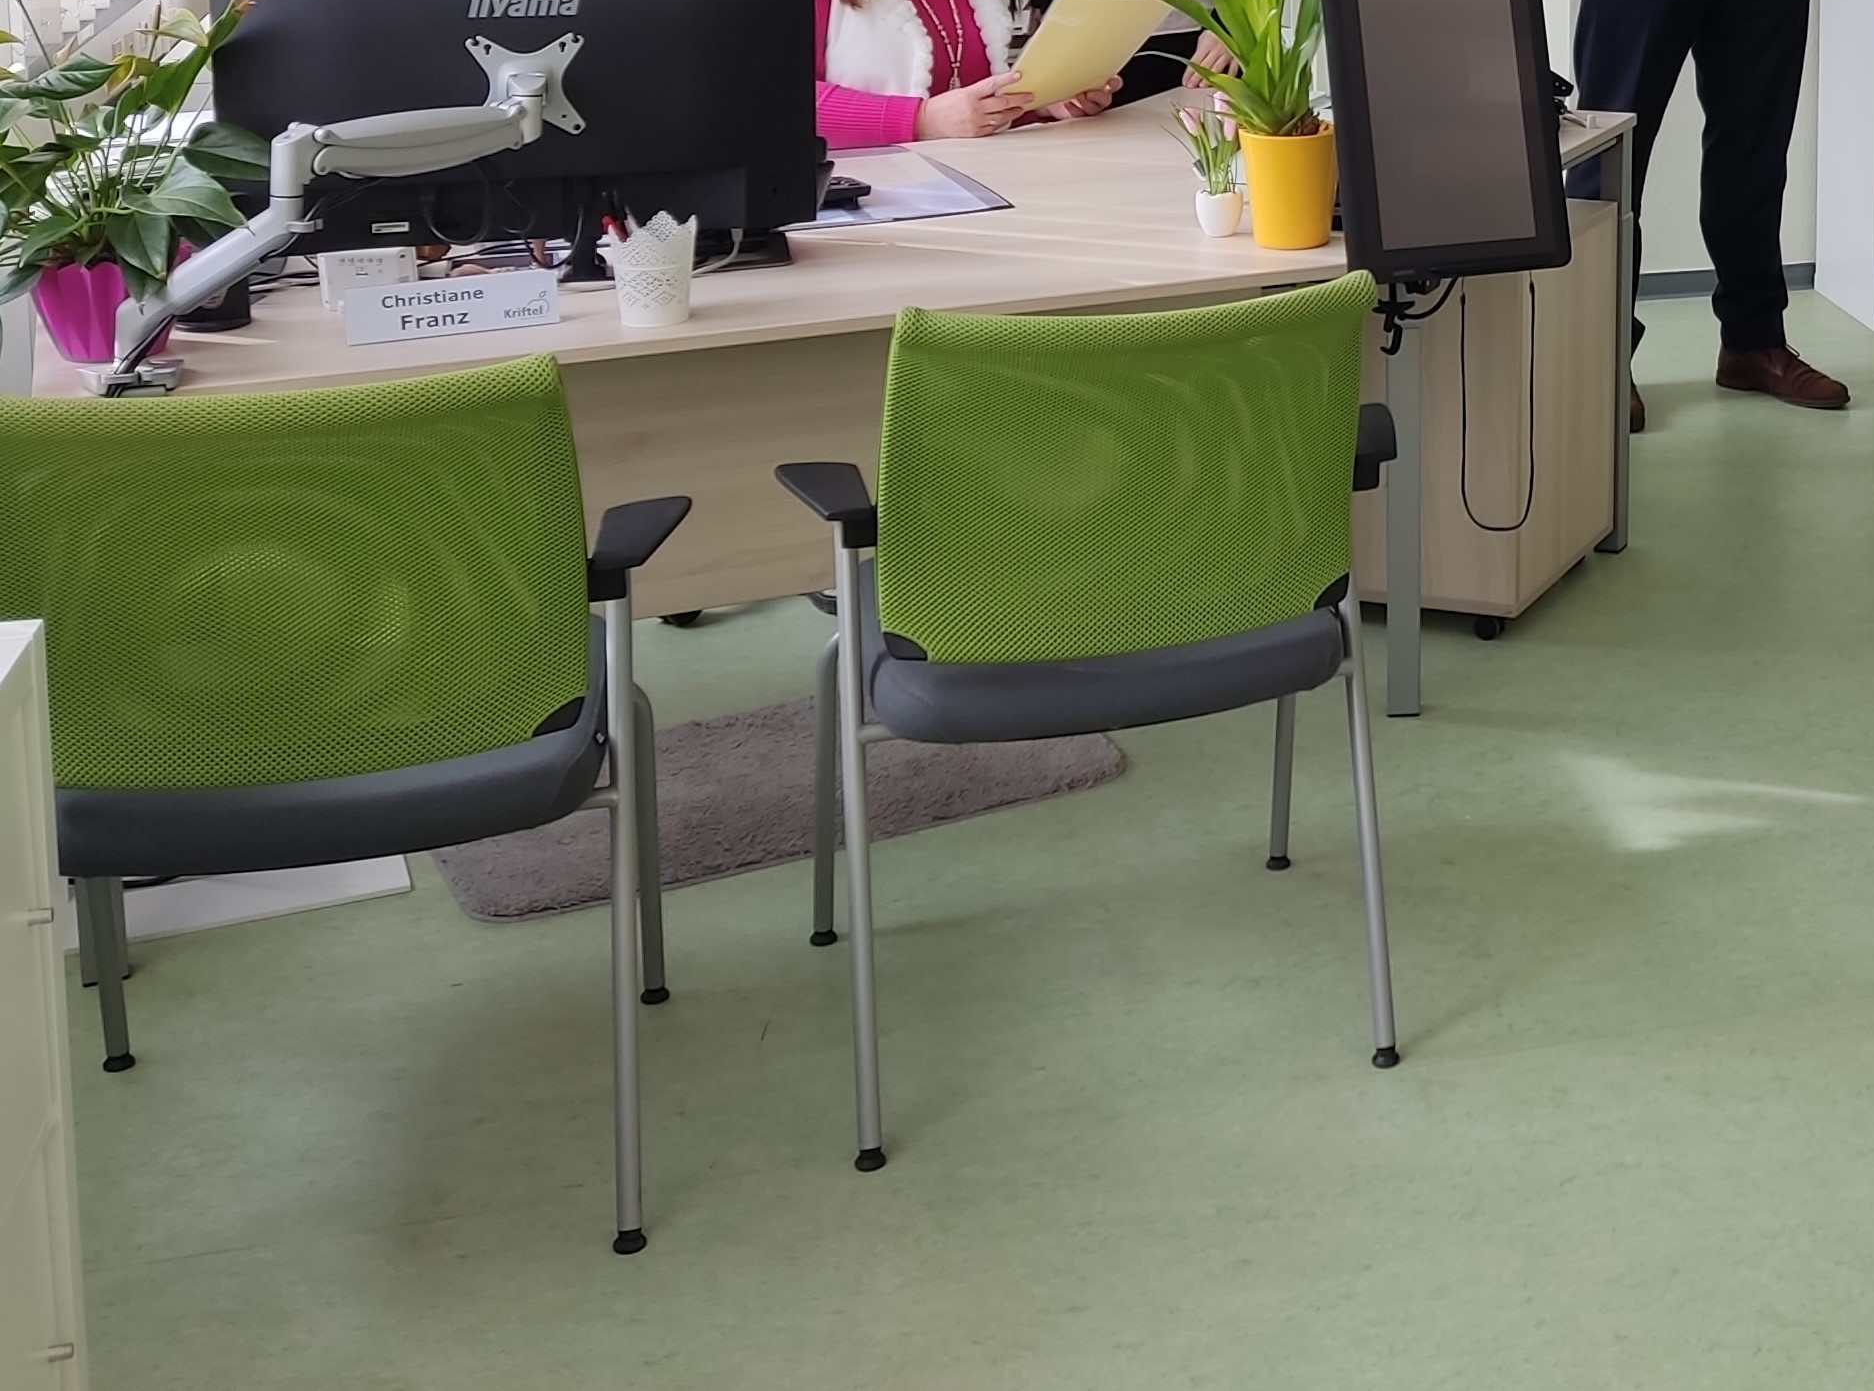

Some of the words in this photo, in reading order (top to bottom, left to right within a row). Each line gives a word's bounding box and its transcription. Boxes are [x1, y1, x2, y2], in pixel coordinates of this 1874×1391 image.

[381, 288, 485, 309] Christiane
[400, 311, 470, 331] Franz
[503, 306, 543, 319] Kriftel
